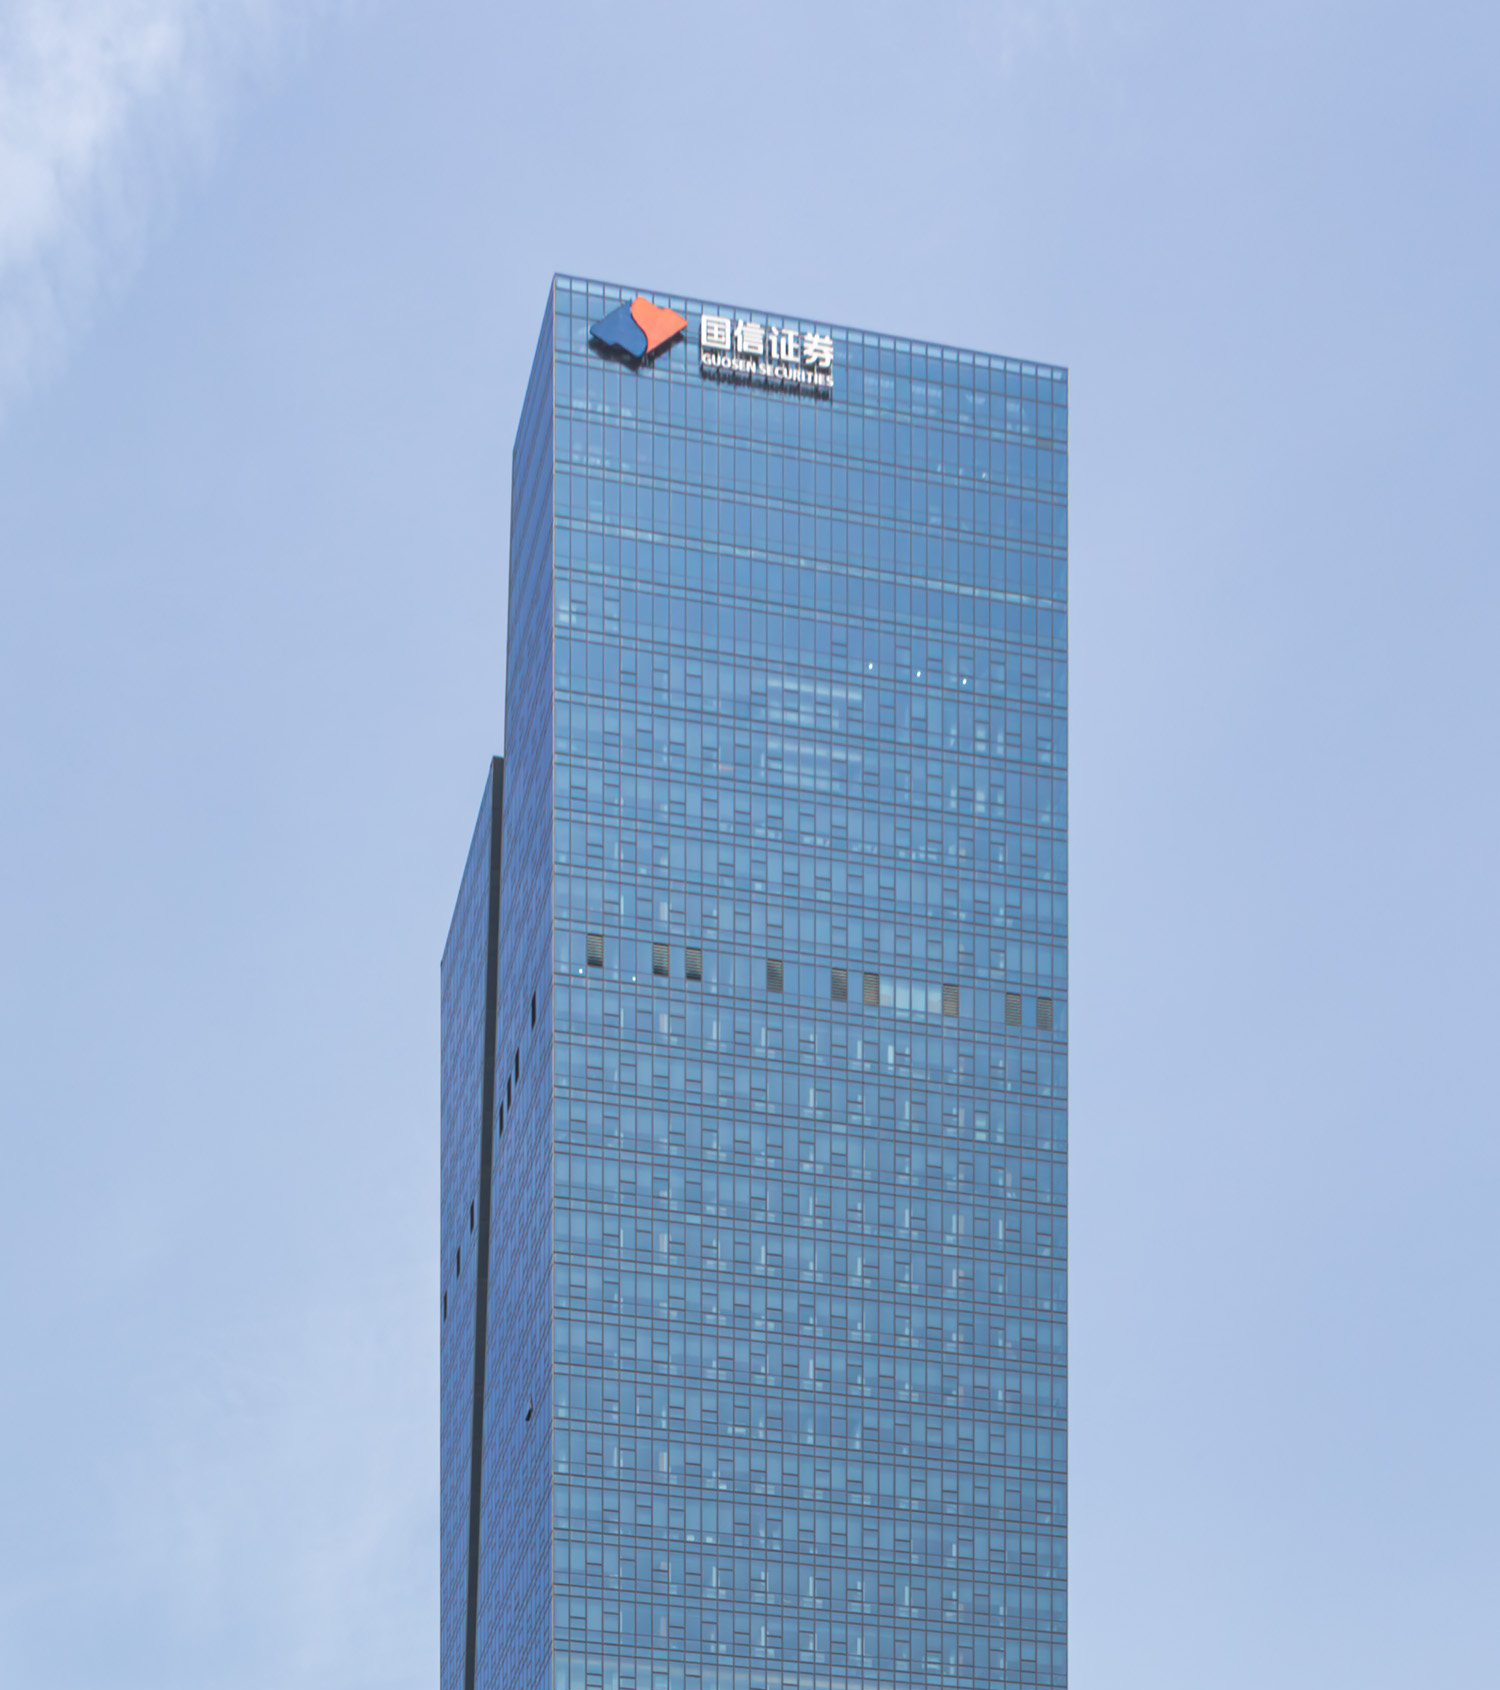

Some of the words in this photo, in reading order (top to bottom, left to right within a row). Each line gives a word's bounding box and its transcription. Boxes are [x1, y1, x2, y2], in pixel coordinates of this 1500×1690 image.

[701, 314, 834, 368] 国信证券
[702, 351, 757, 374] GUOSEN
[759, 361, 834, 387] SECURITIES
